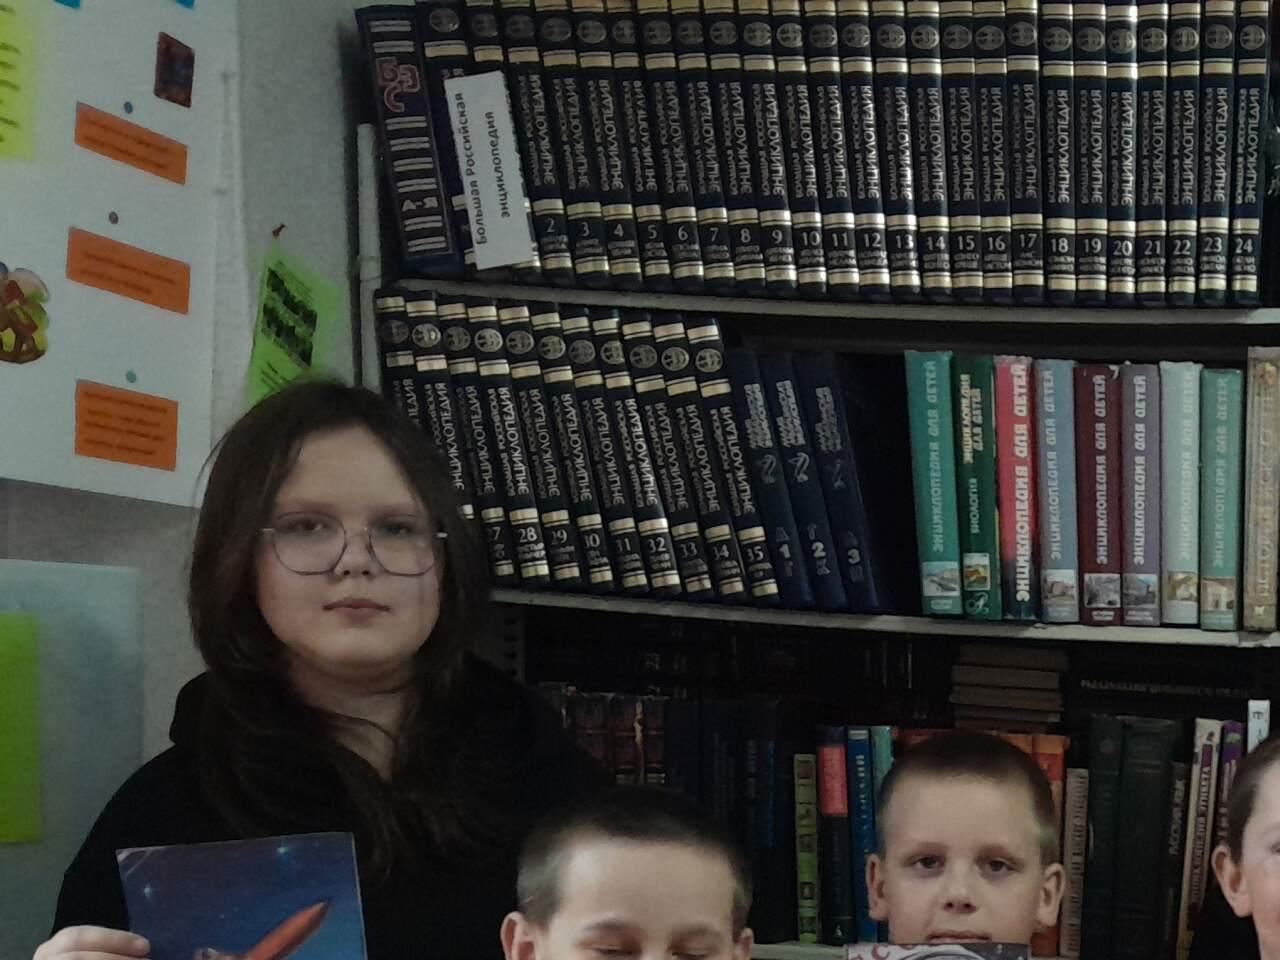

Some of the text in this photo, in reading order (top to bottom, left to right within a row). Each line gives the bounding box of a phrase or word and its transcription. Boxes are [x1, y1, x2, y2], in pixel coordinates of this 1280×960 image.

[1056, 89, 1071, 204] ЭНЦИКЛОПЕДИЯ
[1090, 89, 1104, 204] ЭНЦИКЛОПЕДИЯ
[1120, 91, 1134, 206] ЭНЦИКЛОПЕДИЯ
[1151, 89, 1167, 205] ЭНЦИКЛОПЕДИЯ
[1182, 89, 1196, 205] ЭНЦИКЛОПЕДИЯ
[1212, 87, 1228, 203] ЭНЦИКЛОПЕДИЯ
[1244, 87, 1261, 204] ЭНЦИКЛОПЕДИЯ
[454, 93, 487, 248] Большая Российская
[485, 111, 510, 219] энциклопедия
[544, 218, 556, 233] 2
[580, 221, 591, 236] 3
[612, 223, 624, 237] 4
[647, 224, 657, 239] 5
[677, 225, 689, 240] 6
[709, 227, 719, 241] 7
[740, 228, 751, 243] 8
[771, 229, 783, 244] 9
[802, 231, 820, 246] 10
[831, 232, 848, 247] 11
[863, 232, 881, 247] 12
[895, 235, 913, 249] 13
[926, 235, 946, 250] 14
[957, 235, 975, 250] 15
[987, 236, 1006, 251] 16
[1019, 232, 1037, 249] 17
[1050, 237, 1069, 254] 18
[1084, 238, 1102, 254] 19
[1113, 240, 1133, 256] 20
[1143, 240, 1161, 256] 21
[1172, 239, 1191, 256] 22
[1203, 236, 1222, 253] 23
[1235, 237, 1254, 254] 24
[465, 385, 496, 494] ЭНЦИКЛОПЕДИЯ
[498, 387, 530, 495] ЭНЦИКЛОПЕДИЯ
[560, 393, 593, 502] ЭНЦИКЛОПЕДИЯ
[624, 398, 658, 506] ЭНЦИКЛОПЕДИЯ
[719, 405, 756, 514] ЭНЦИКЛОПЕДИЯ
[924, 360, 944, 553] ЭНЦИКЛОПЕДИЯ ДЛЯ ДЕТЕЙ
[1042, 370, 1062, 561] ЭНЦИКЛОПЕДИЯ ДЛЯ ДЕТЕЙ
[1092, 374, 1109, 565] ЭНЦИКЛОПЕДИЯ ДЛЯ ДЕТЕЙ
[1132, 374, 1147, 566] ЭНЦИКЛОПЕДИЯ ДЛЯ ДЕТЕЙ
[1010, 362, 1031, 603] ЭНЦИКЛОПЕДИЯ ДЛЯ ДЕТЕЙ
[519, 526, 537, 543] 28
[648, 537, 667, 552] 32
[779, 543, 791, 559] 1
[811, 541, 826, 558] 2
[847, 548, 861, 565] 3
